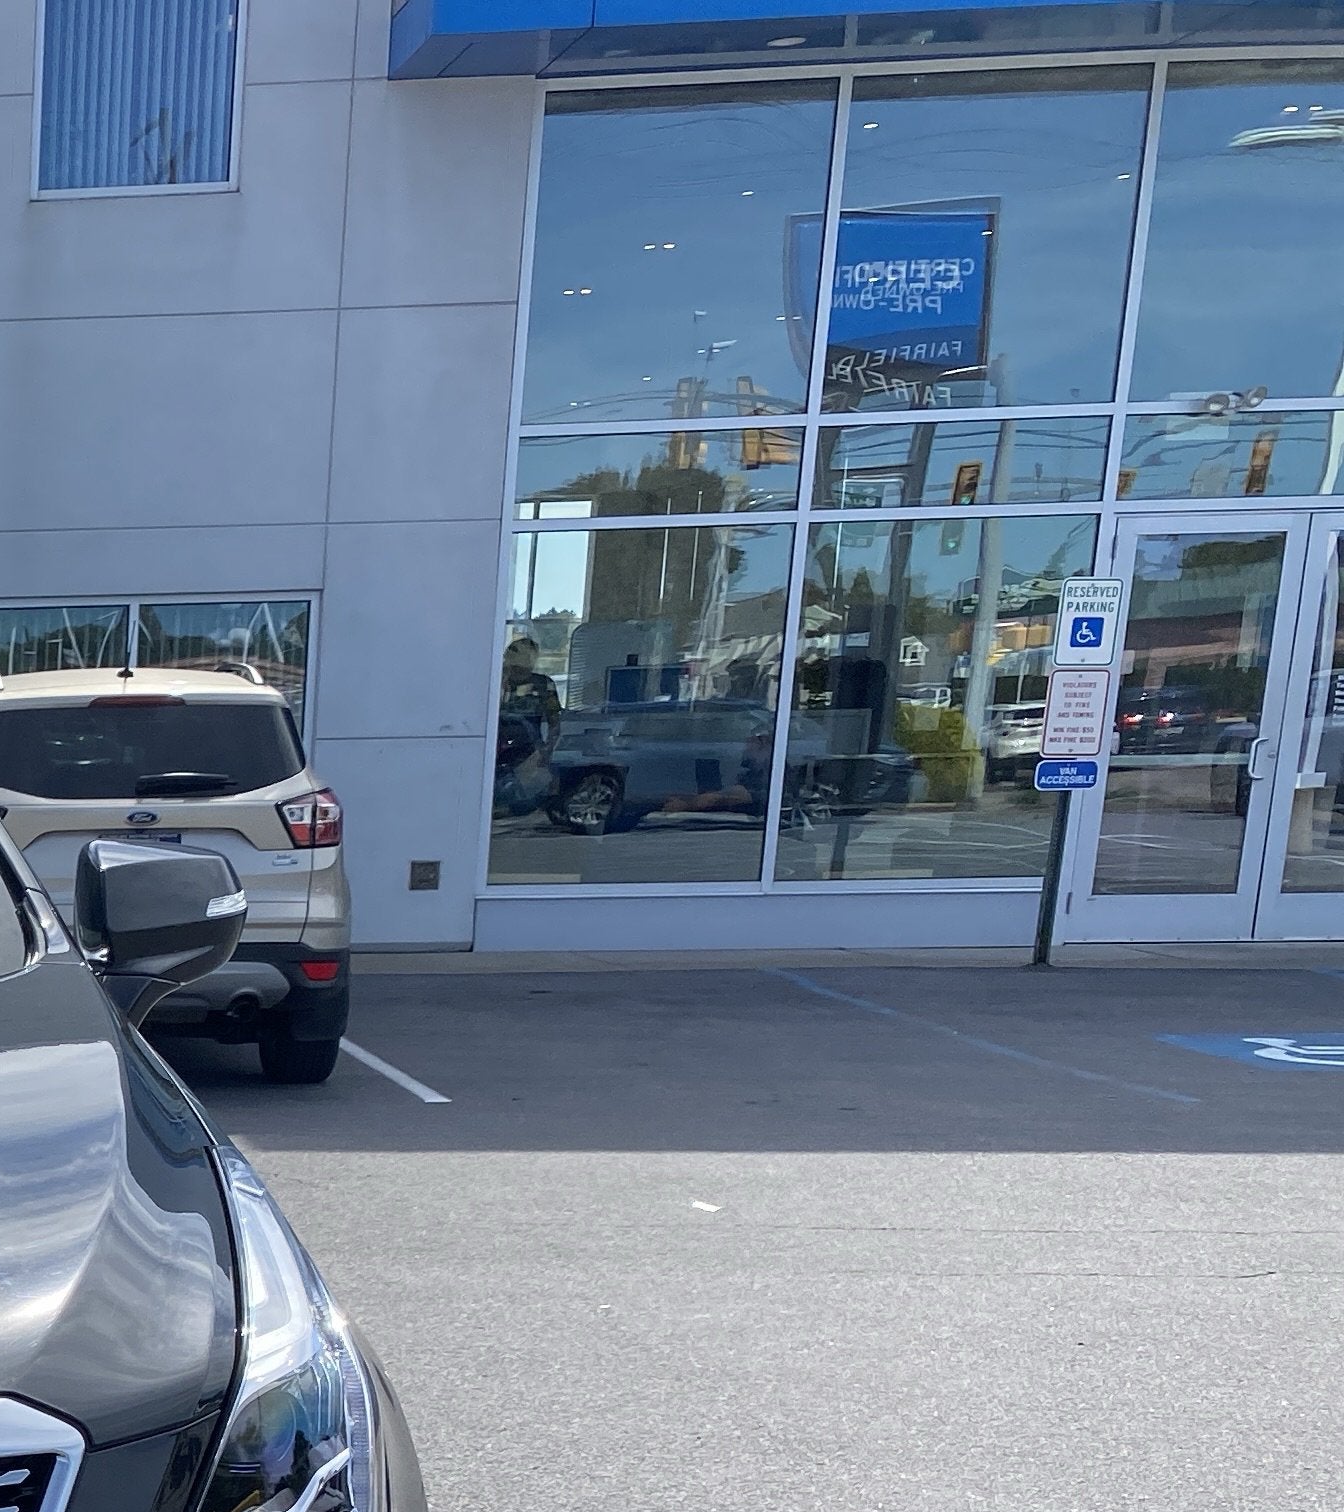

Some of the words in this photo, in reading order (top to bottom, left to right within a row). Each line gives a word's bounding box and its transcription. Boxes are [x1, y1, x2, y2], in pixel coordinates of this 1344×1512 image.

[1066, 585, 1119, 598] RESERVED
[1066, 601, 1115, 613] PARKING
[1059, 767, 1078, 775] VAN
[1039, 775, 1095, 785] ACCESSIBLE
